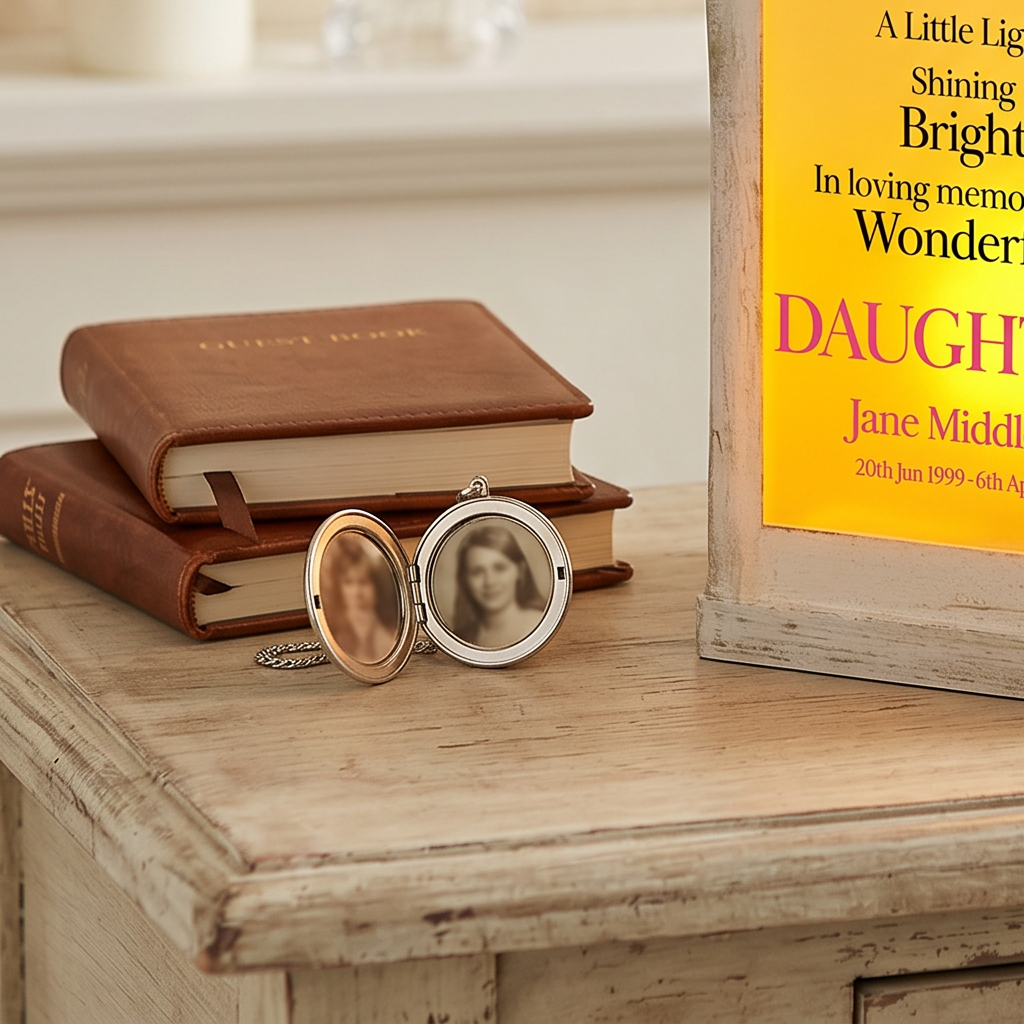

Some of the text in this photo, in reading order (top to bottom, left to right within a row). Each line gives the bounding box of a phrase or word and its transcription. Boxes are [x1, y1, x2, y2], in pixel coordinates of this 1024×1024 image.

[875, 9, 898, 39] A
[904, 11, 974, 45] Little
[911, 66, 1017, 112] Shining
[814, 163, 842, 195] In
[848, 167, 931, 213] loving
[843, 398, 919, 444] Jane
[855, 458, 893, 480] 20th
[895, 462, 923, 485] Jun
